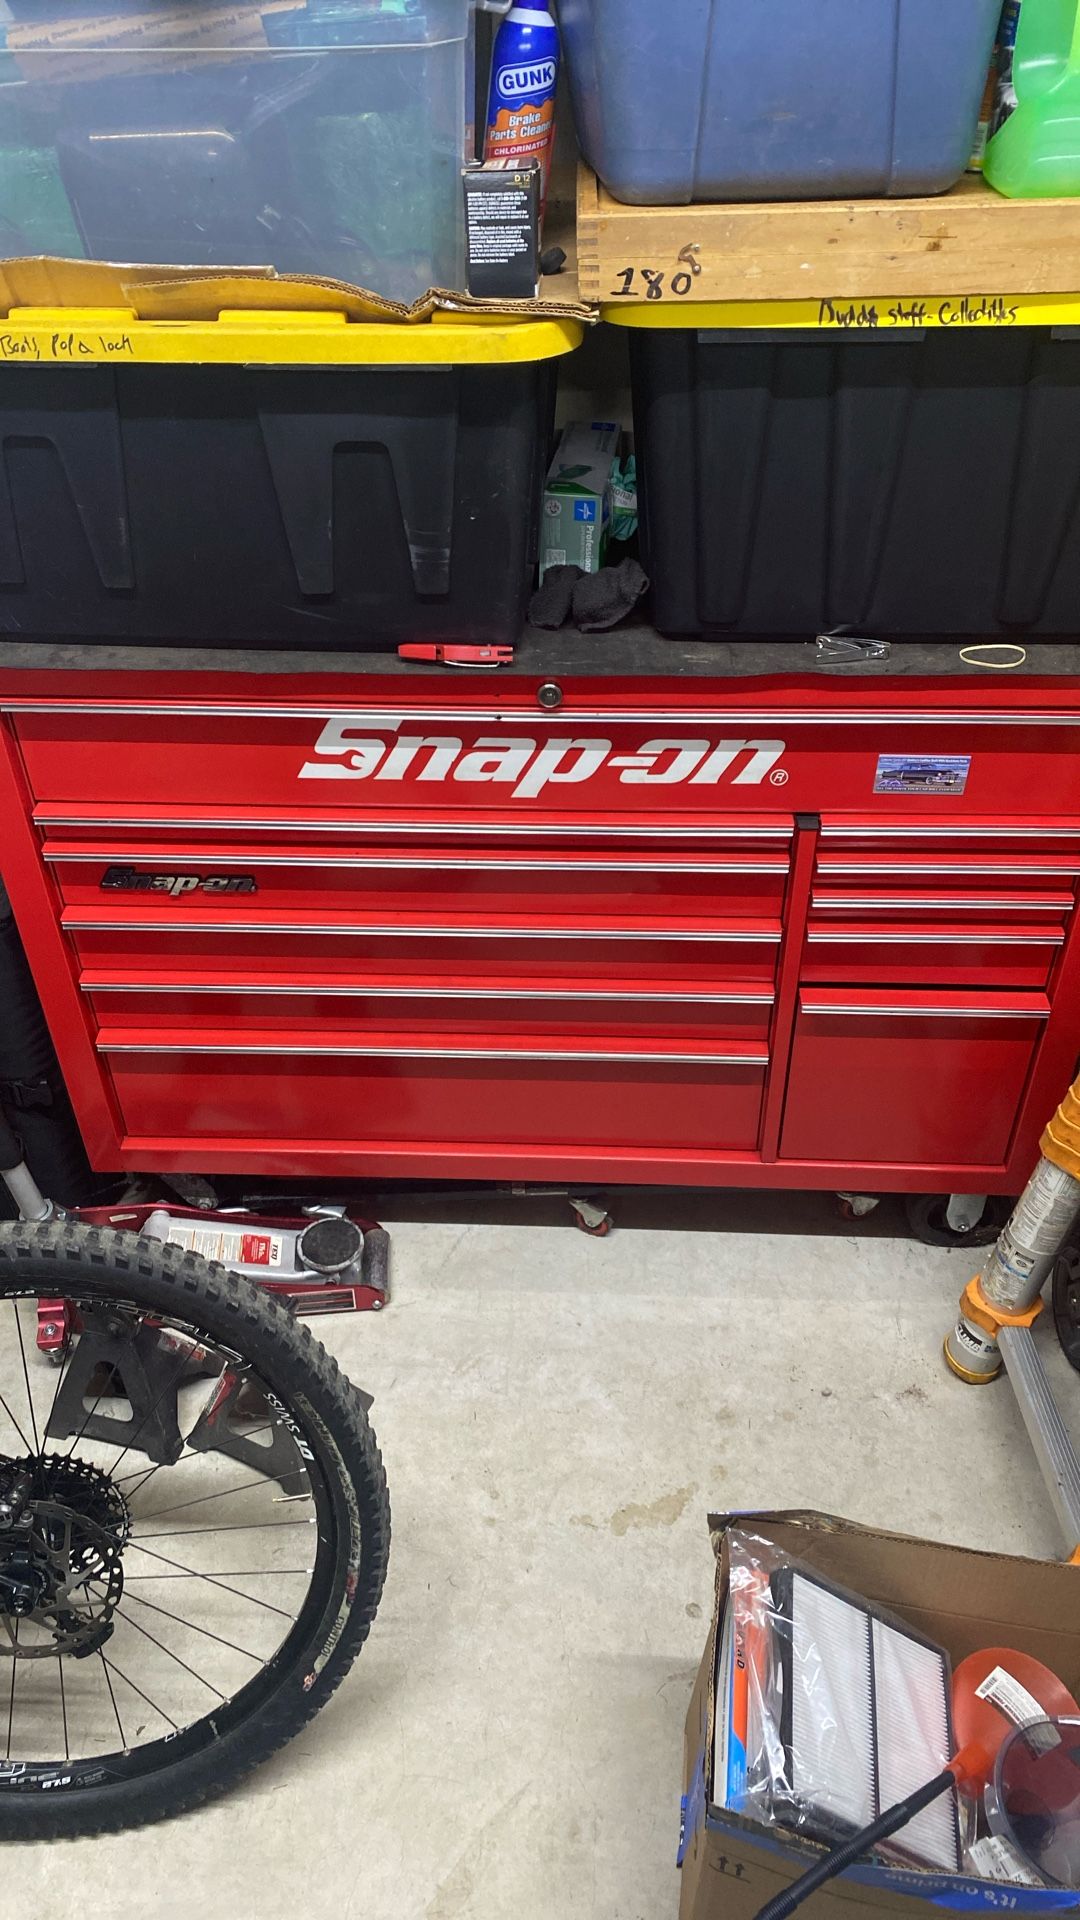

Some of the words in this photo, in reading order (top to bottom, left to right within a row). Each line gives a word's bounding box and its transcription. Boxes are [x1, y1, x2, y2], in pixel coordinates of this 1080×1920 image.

[502, 66, 553, 90] GUNK
[509, 112, 541, 127] Brake
[490, 129, 517, 141] Parts
[494, 138, 549, 156] CHLORINATED
[523, 174, 531, 182] 12
[298, 717, 787, 798] Snap-on
[102, 867, 254, 896] Snap-on
[263, 1392, 300, 1433] SWISS
[293, 1435, 315, 1461] DT
